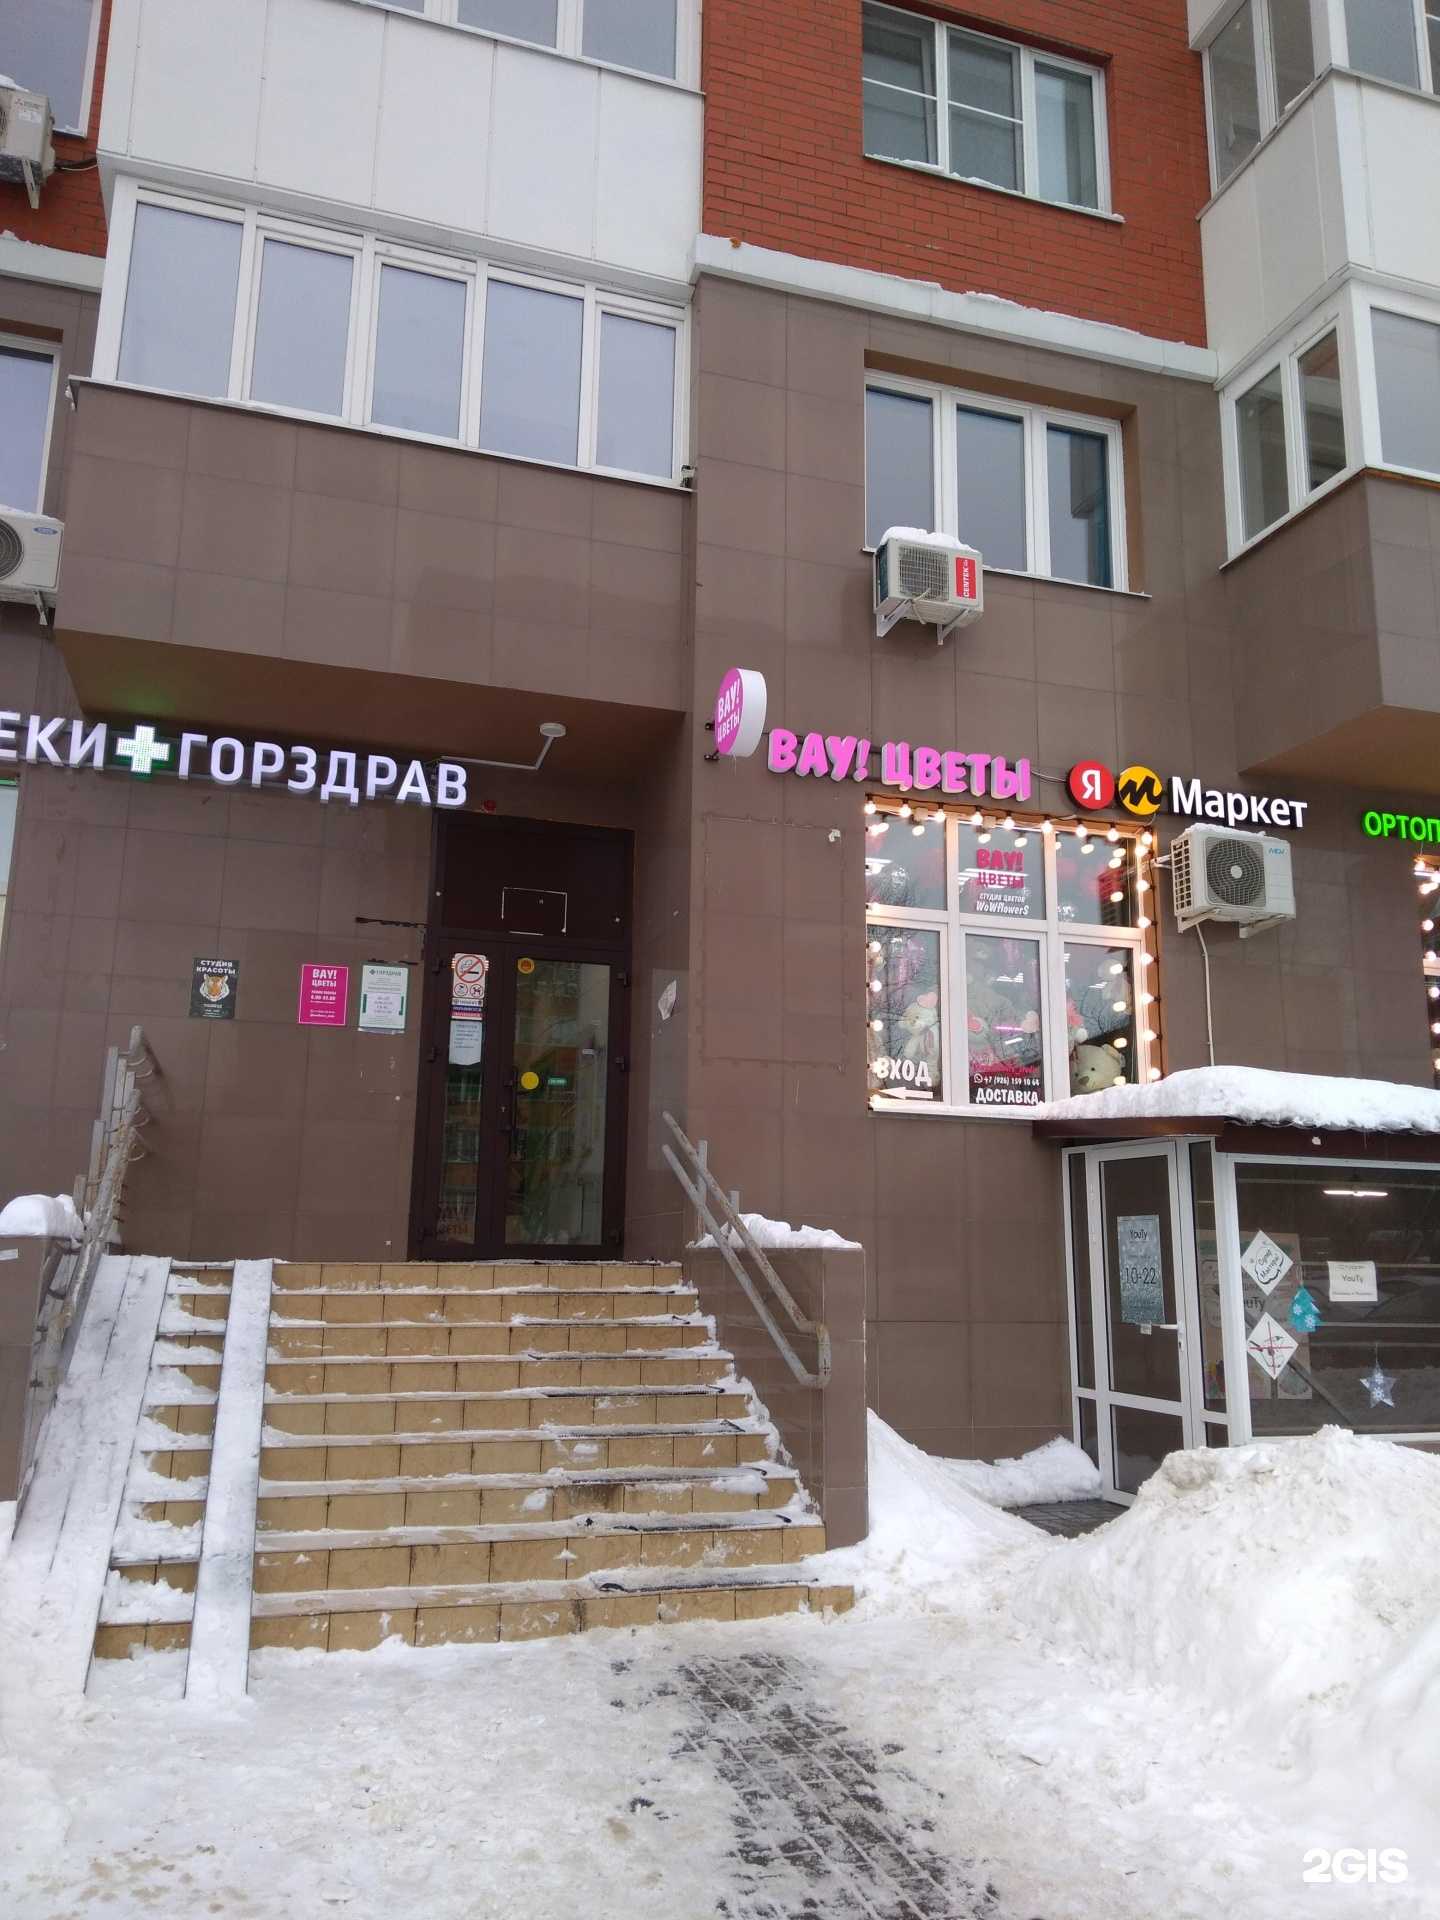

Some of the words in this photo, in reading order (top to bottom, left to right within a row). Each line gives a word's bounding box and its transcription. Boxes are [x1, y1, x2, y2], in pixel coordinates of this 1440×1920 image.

[718, 678, 741, 723] ВАУ!
[717, 707, 740, 744] ЦВЕТЫ
[178, 732, 469, 808] ГОРЗДРАВ
[768, 728, 871, 782] ВАУ!
[881, 741, 1031, 802] ЦВЕТЫ
[1081, 769, 1101, 800] Я
[1171, 776, 1308, 828] Маркет
[1364, 811, 1440, 843] ОРТОП
[976, 848, 1024, 872] ВАУ!
[196, 966, 236, 975] КРАСОТЫ
[200, 959, 233, 968] СТУДИЯ
[312, 968, 338, 980] ВАУ!
[311, 979, 337, 988] ЦВЕТЫ
[876, 1056, 932, 1087] ВХОД
[975, 1087, 1039, 1105] ДОСТАВКА
[1125, 1267, 1157, 1285] 10-22
